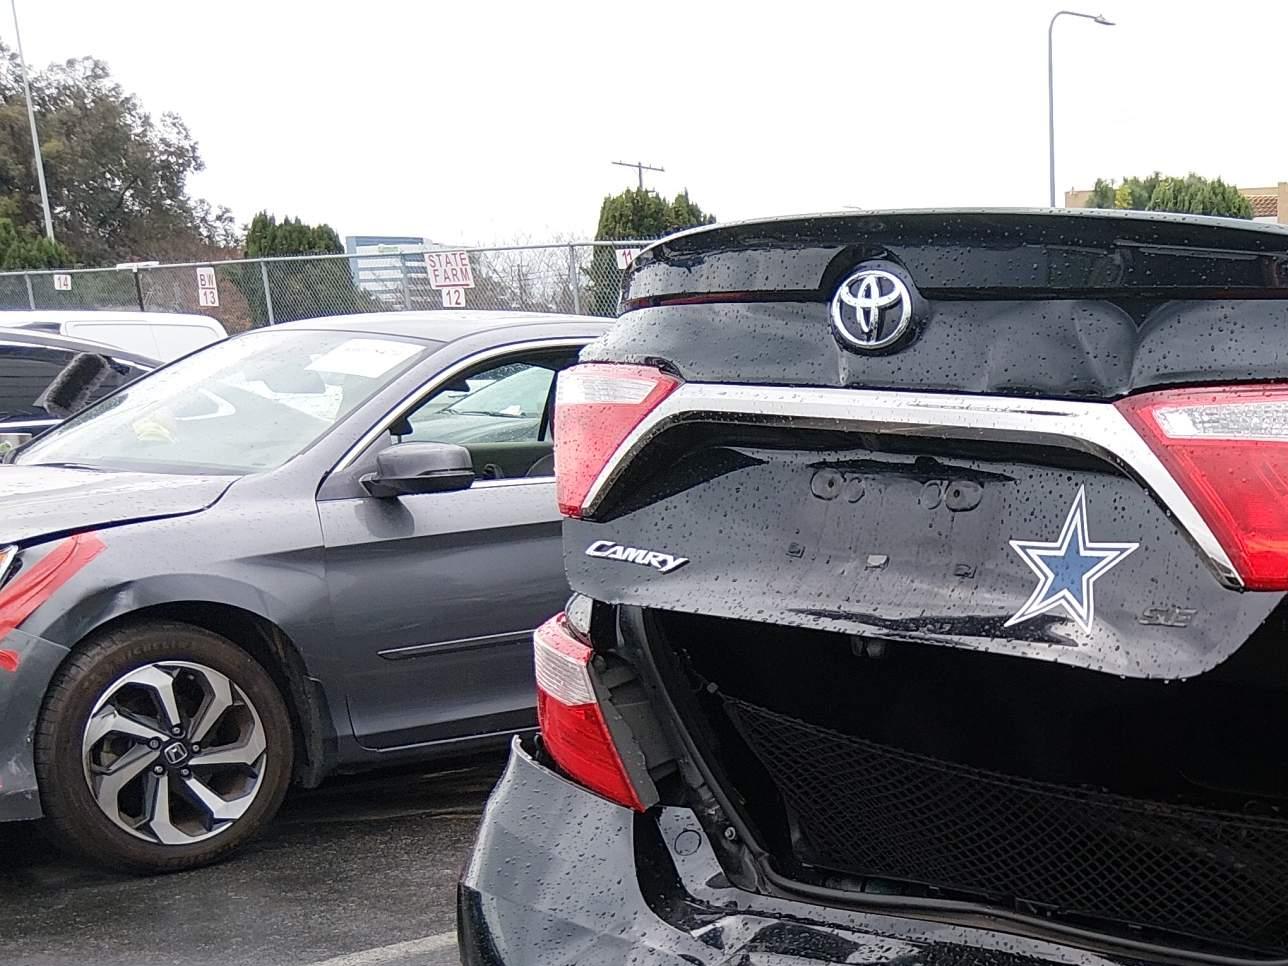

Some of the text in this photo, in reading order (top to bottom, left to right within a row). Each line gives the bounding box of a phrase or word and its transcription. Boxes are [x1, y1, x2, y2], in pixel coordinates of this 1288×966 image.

[428, 253, 468, 268] STATE
[57, 276, 69, 289] 14
[432, 267, 470, 283] FARM
[203, 290, 216, 304] 13
[446, 289, 462, 305] 12
[1139, 607, 1198, 628] SE
